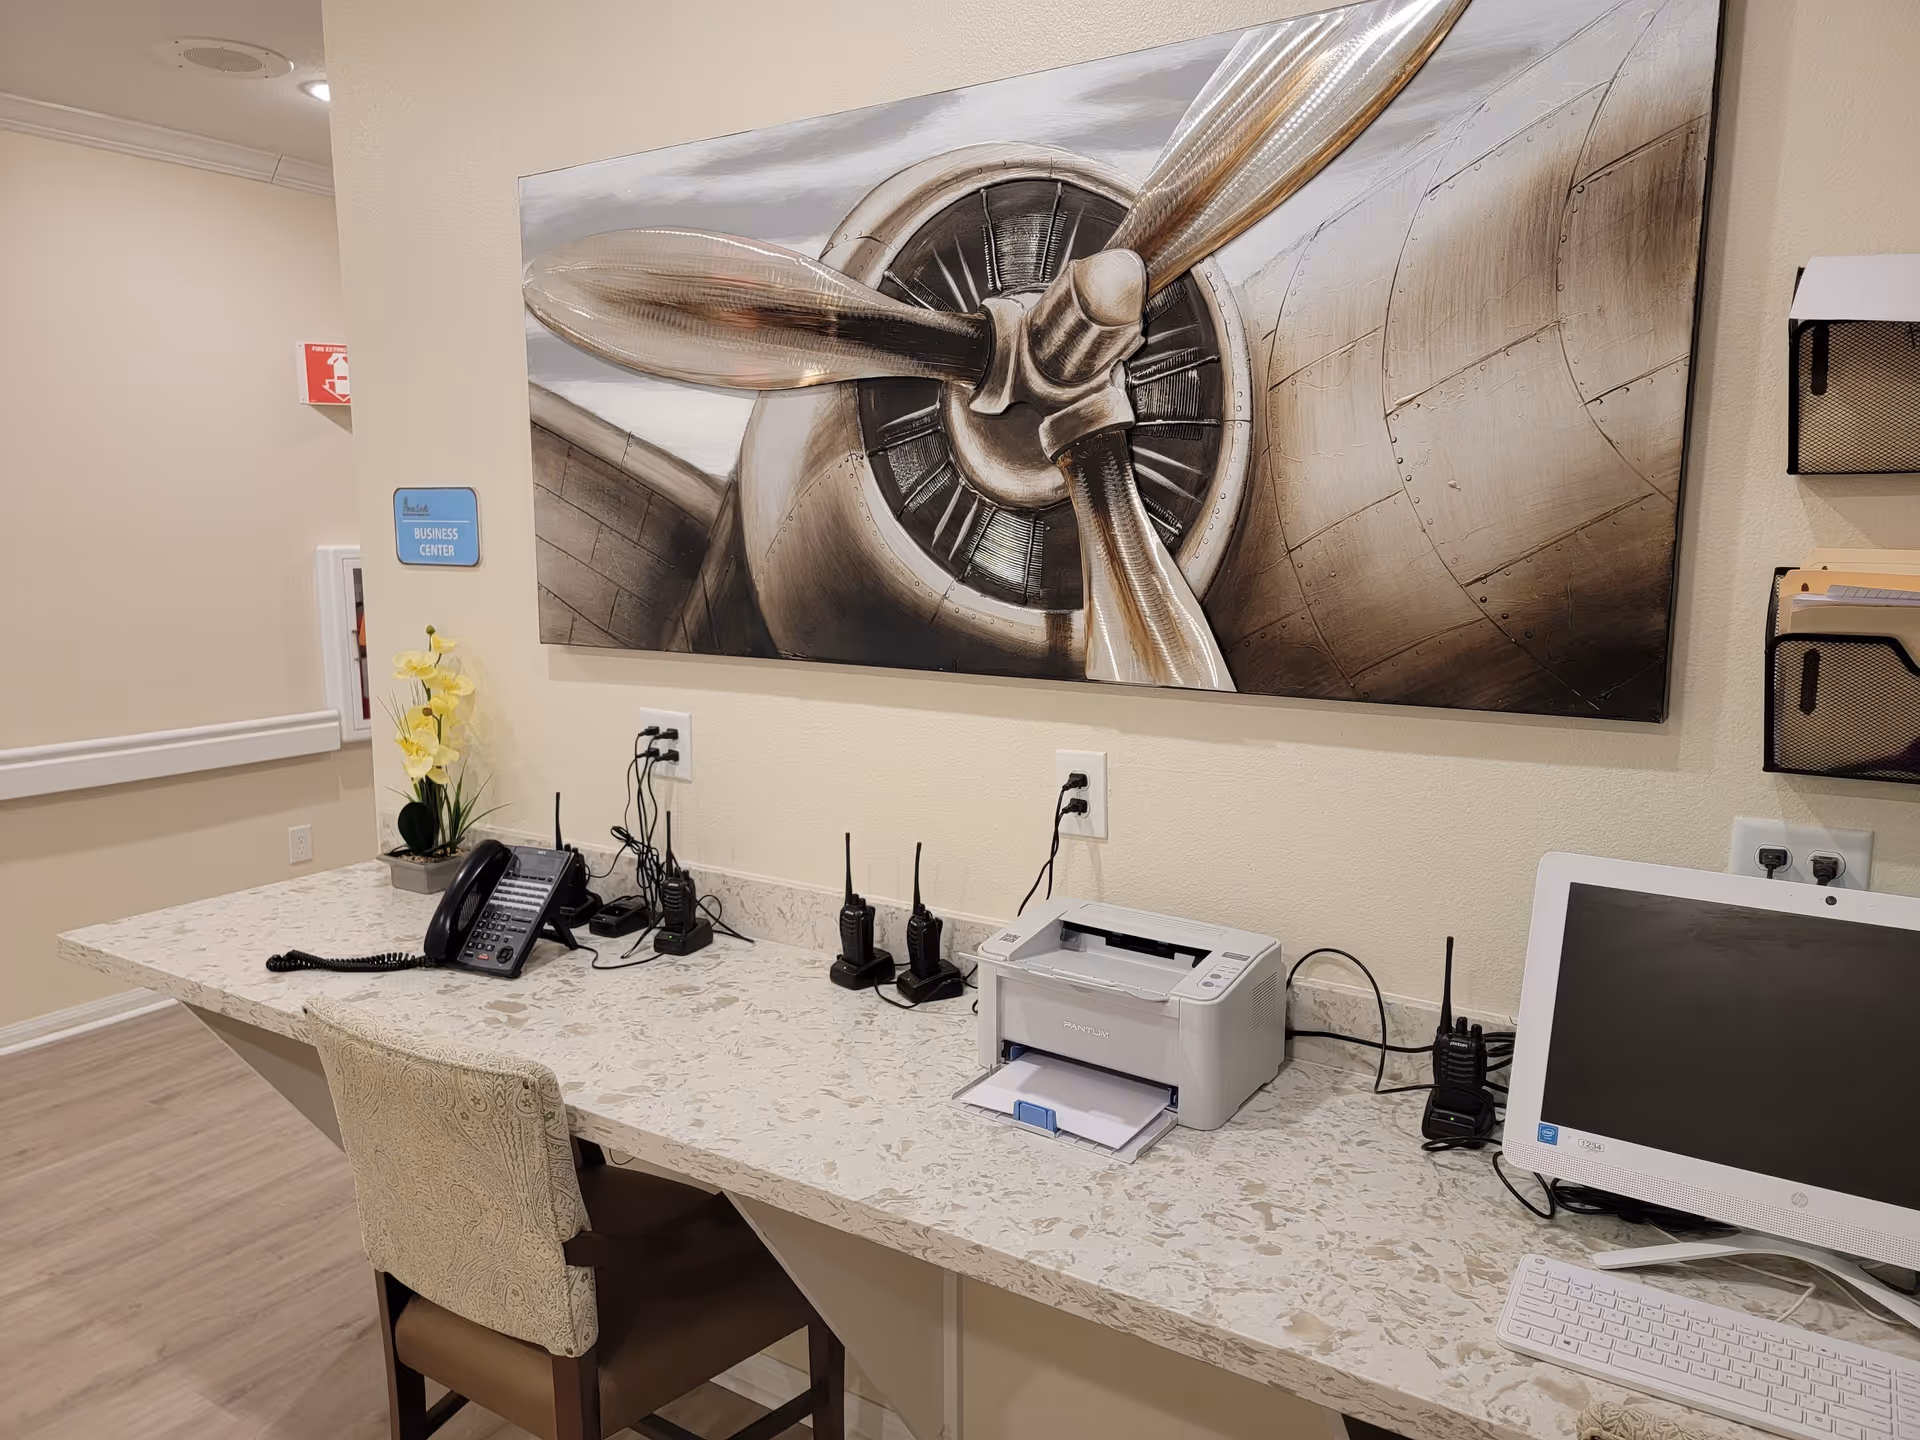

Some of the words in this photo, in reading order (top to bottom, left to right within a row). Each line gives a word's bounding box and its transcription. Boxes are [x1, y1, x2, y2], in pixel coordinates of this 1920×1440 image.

[414, 527, 459, 541] BUSINESS
[419, 544, 455, 556] CENTER
[1063, 1020, 1109, 1039] PANTUM
[1581, 1140, 1602, 1150] 1234
